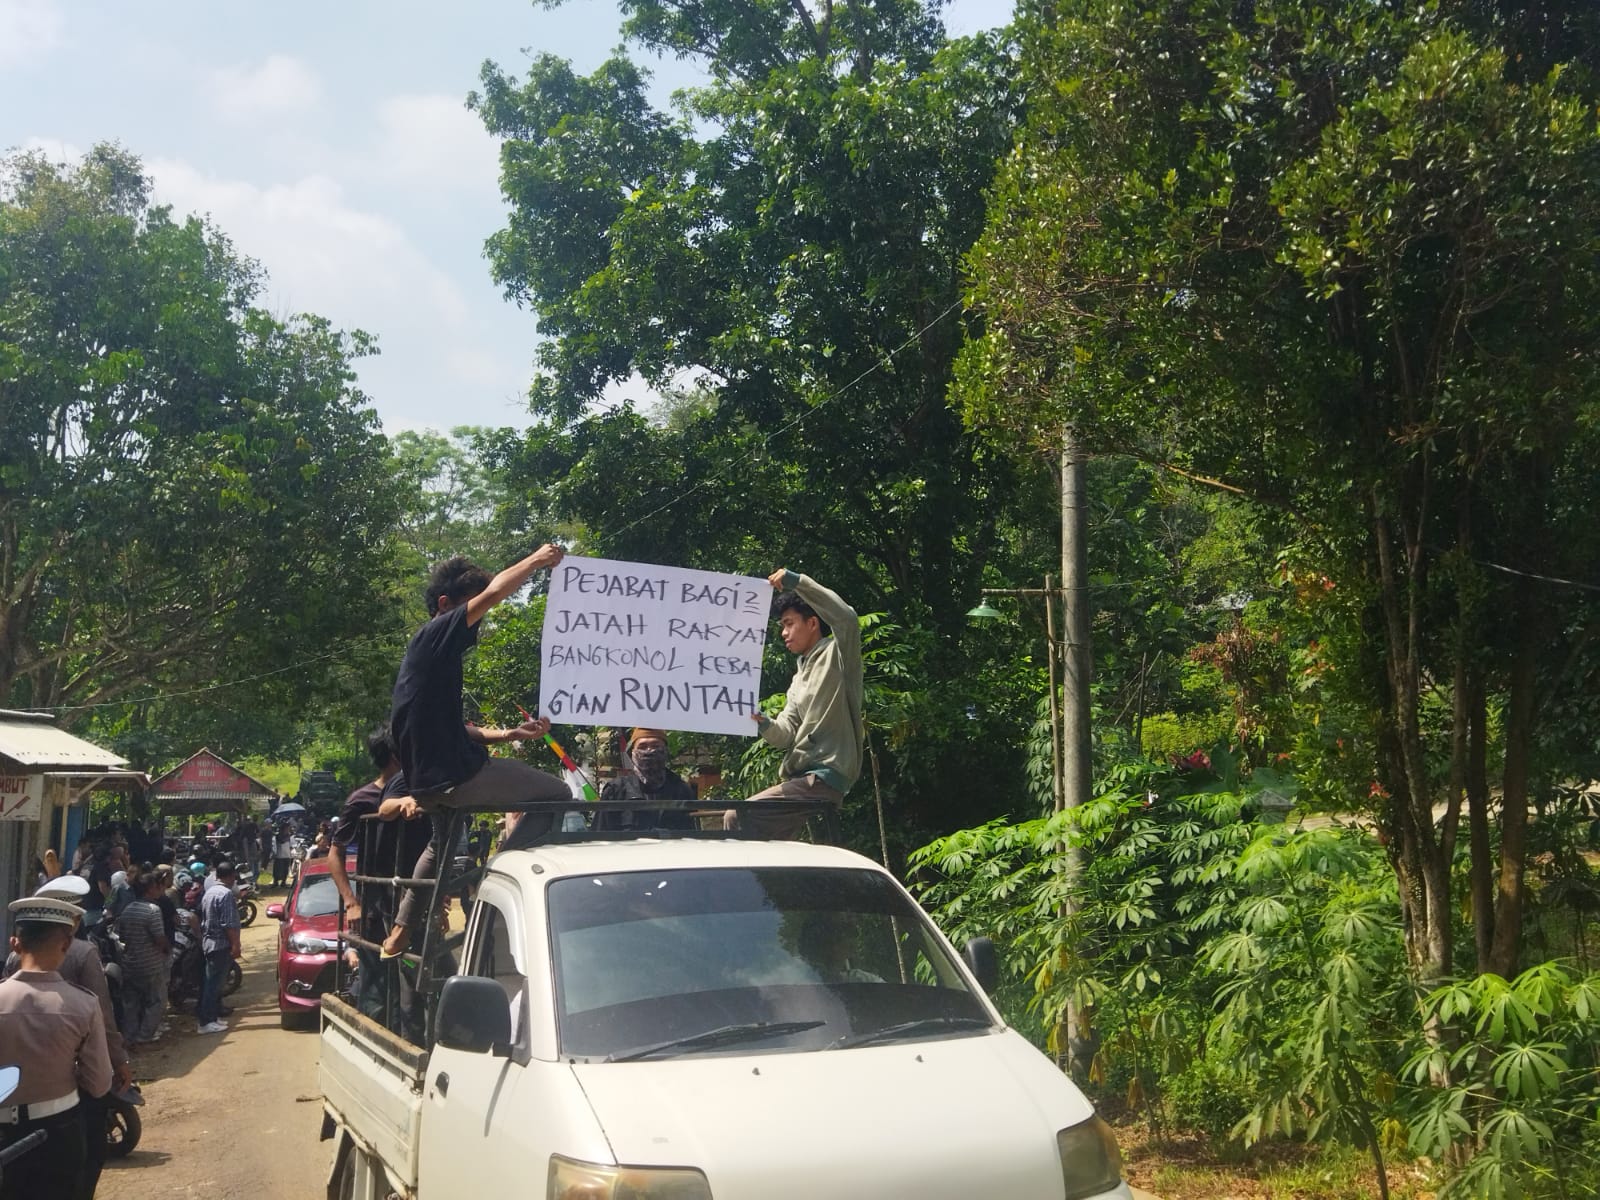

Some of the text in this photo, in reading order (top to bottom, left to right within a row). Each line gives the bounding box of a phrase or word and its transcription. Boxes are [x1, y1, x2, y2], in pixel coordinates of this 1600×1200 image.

[563, 566, 669, 601] PEJABAT
[555, 610, 767, 646] JATAH RAKYAT
[549, 644, 683, 672] BANGKONOL
[619, 677, 755, 716] RUNTAH
